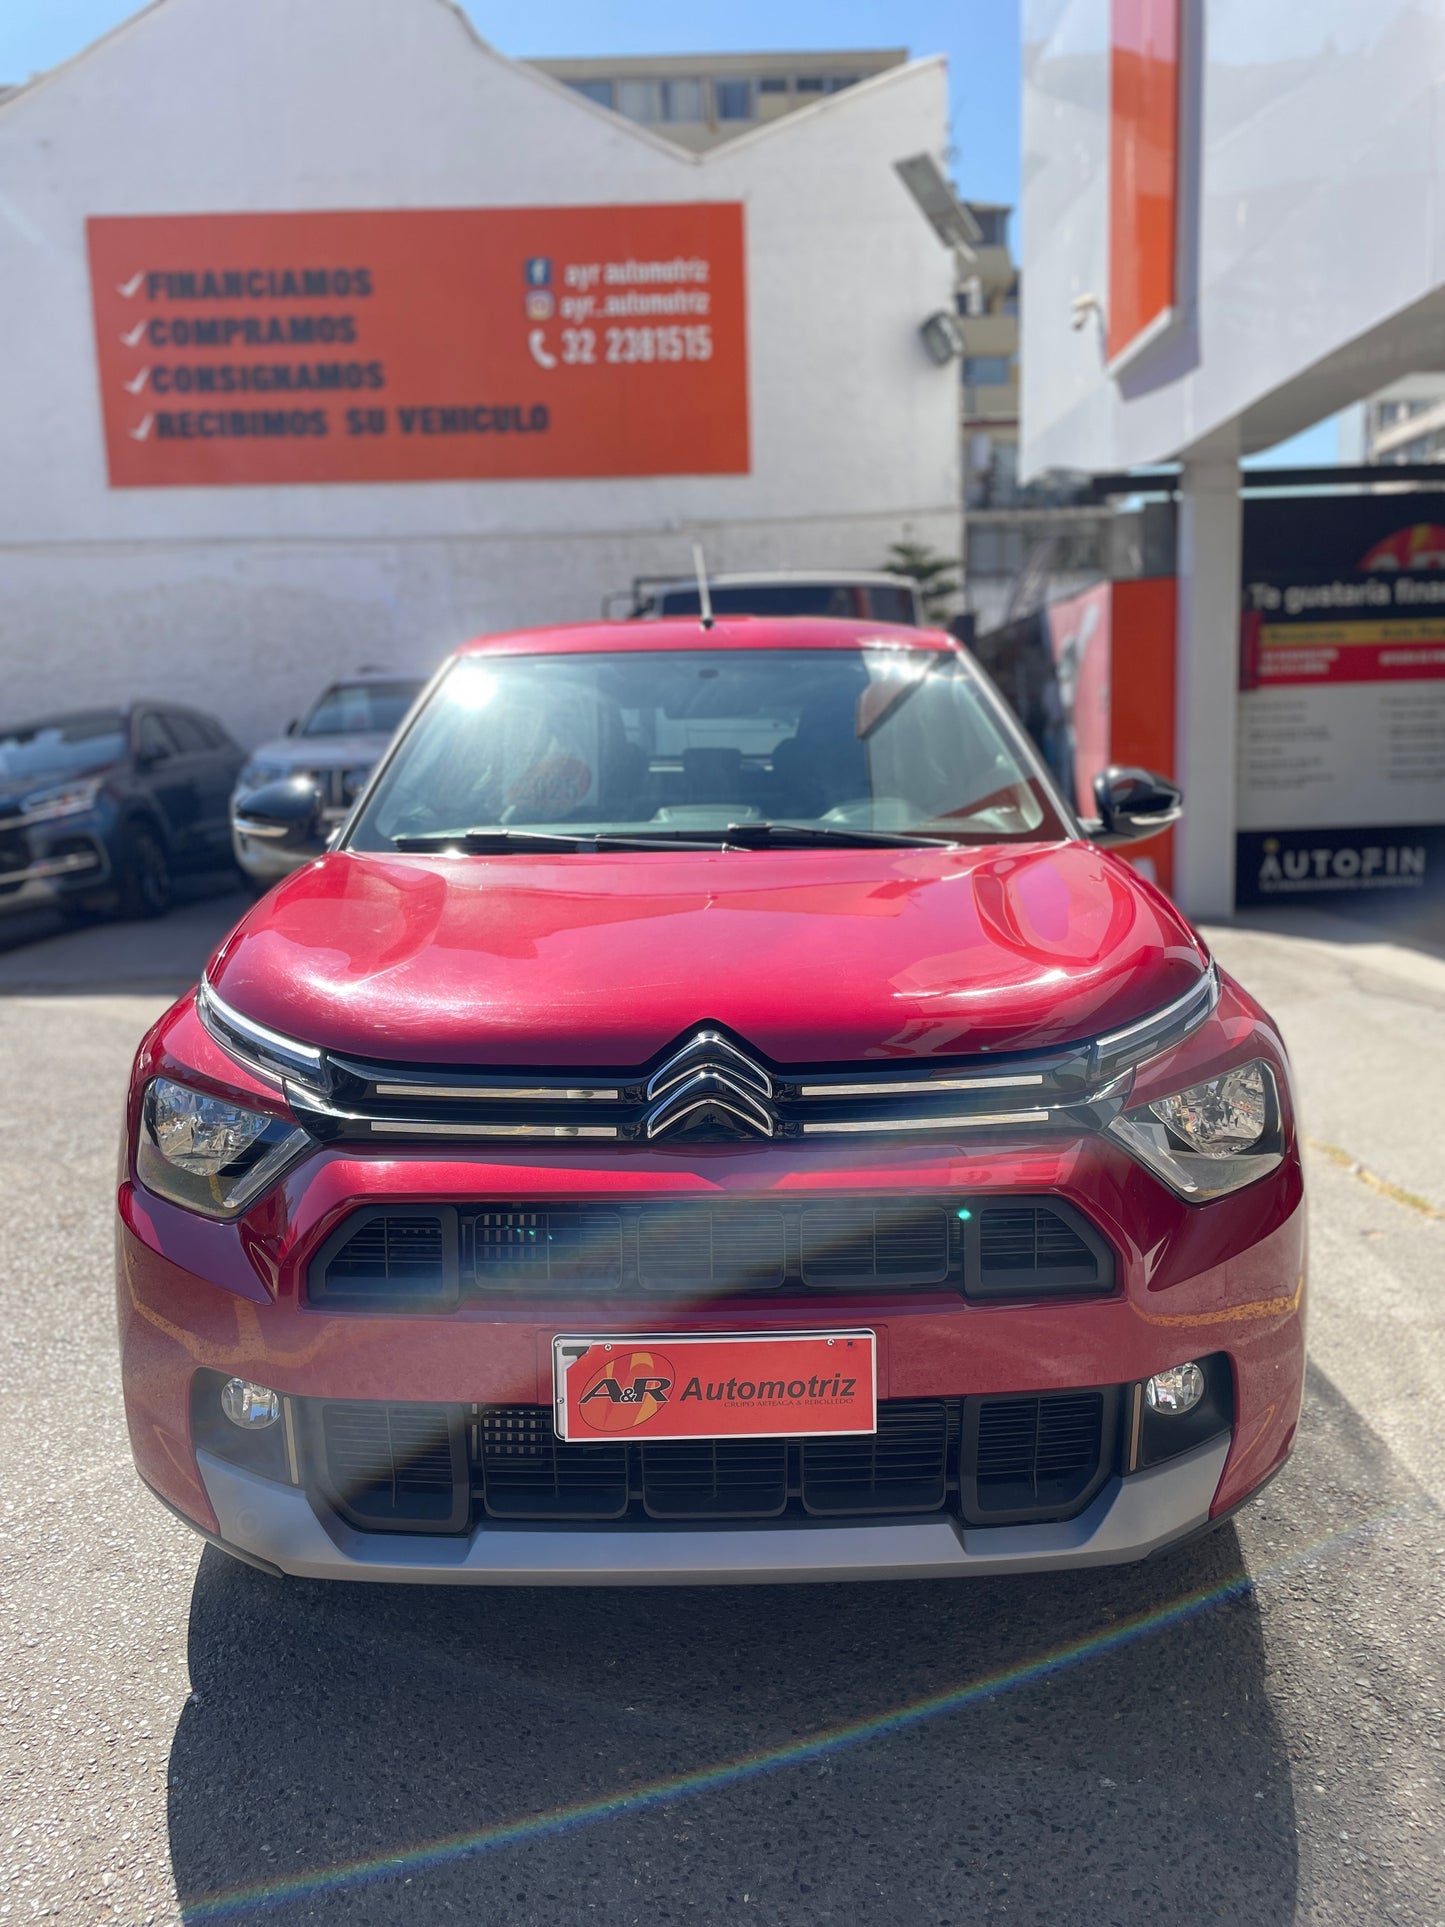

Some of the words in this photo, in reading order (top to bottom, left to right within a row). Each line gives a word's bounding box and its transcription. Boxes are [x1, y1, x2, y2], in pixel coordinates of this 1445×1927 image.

[147, 269, 373, 300] FINANCIAMOS
[565, 263, 601, 291] ayr
[604, 257, 710, 285] automotriz
[148, 315, 357, 347] COMPRAMOS
[561, 327, 597, 365] 32
[604, 324, 713, 364] 2381515
[151, 361, 384, 394] CONSIGNAMOS
[156, 409, 329, 440] RECIBIMOS
[345, 408, 387, 436] SU
[397, 404, 549, 435] VEHICULO
[1259, 840, 1426, 881] AUTOFIN
[579, 1376, 672, 1404] A&R
[680, 1373, 857, 1402] Automotriz
